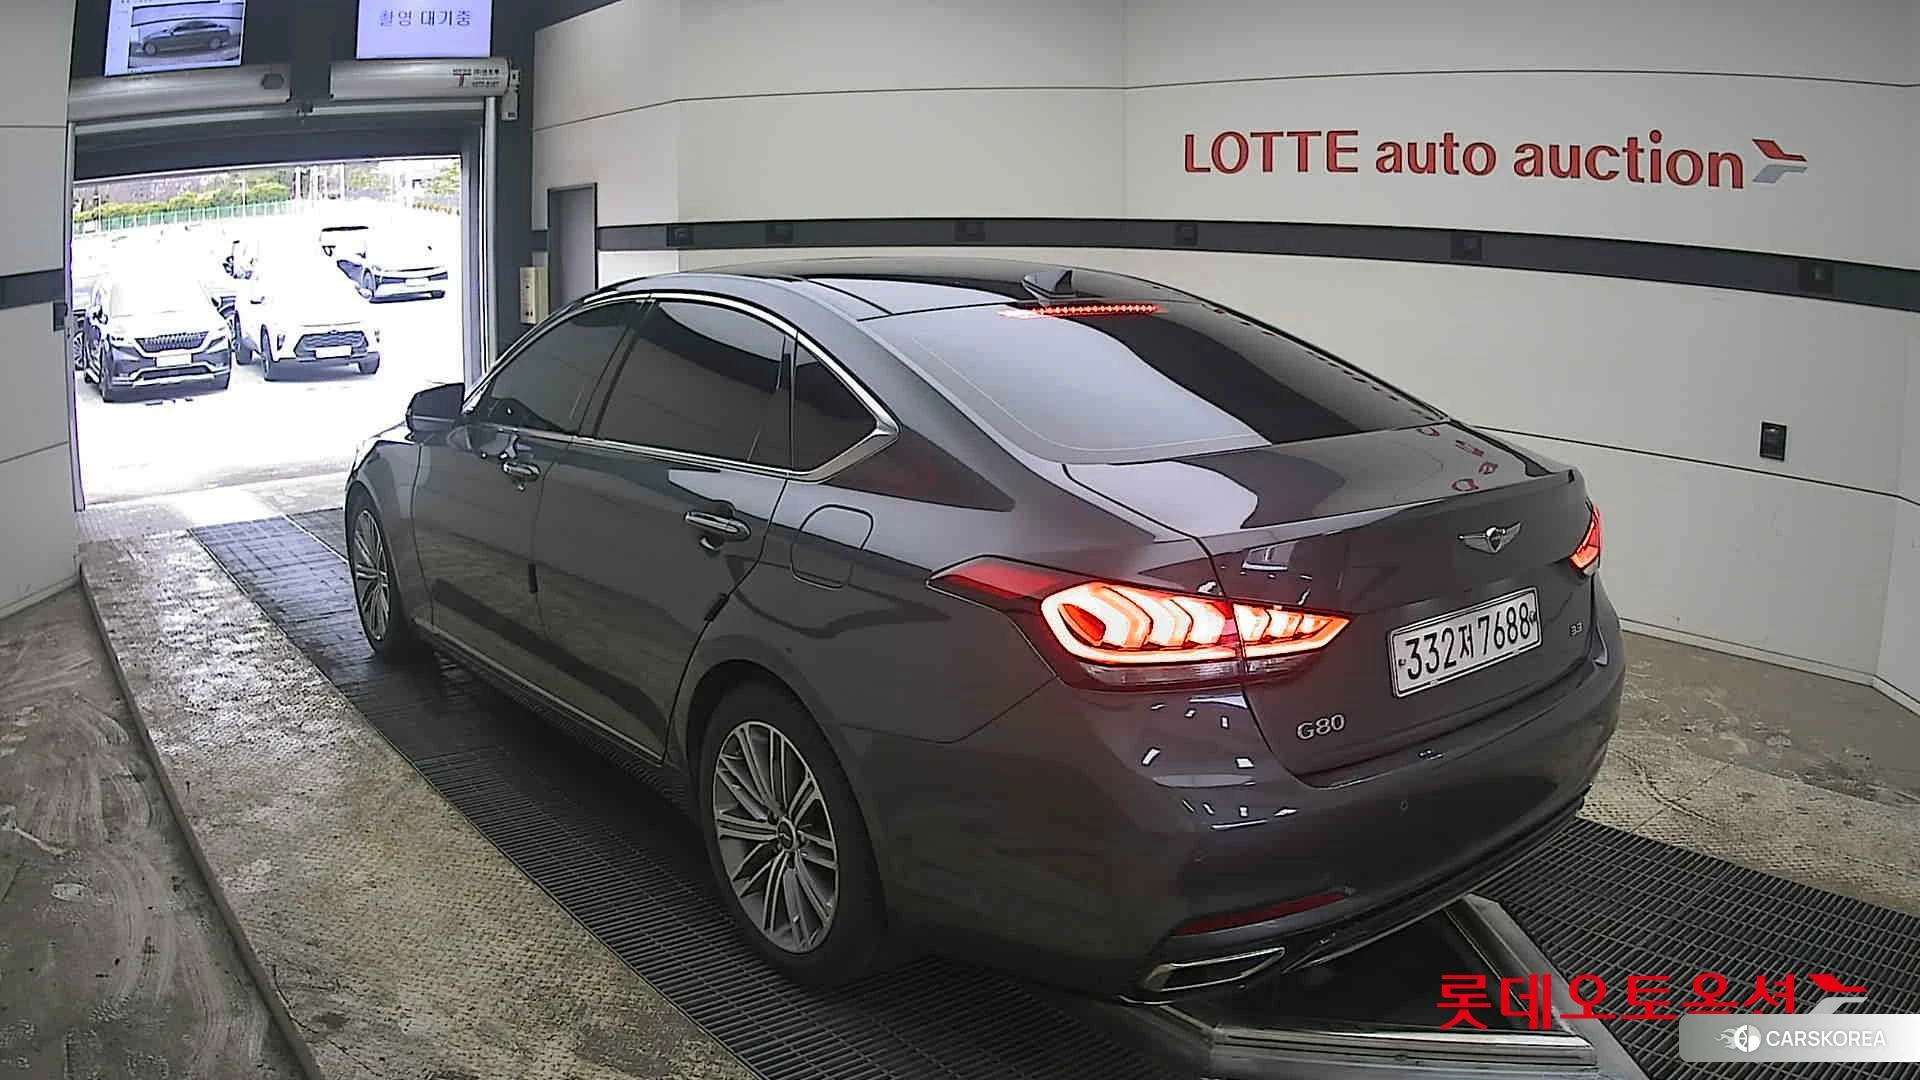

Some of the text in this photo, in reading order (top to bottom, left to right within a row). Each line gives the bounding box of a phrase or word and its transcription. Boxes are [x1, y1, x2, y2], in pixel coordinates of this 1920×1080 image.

[420, 9, 472, 27] 대기중
[1185, 129, 1744, 189] LOTTE auto auction
[1404, 601, 1531, 680] 332저7688
[1296, 714, 1346, 740] G80
